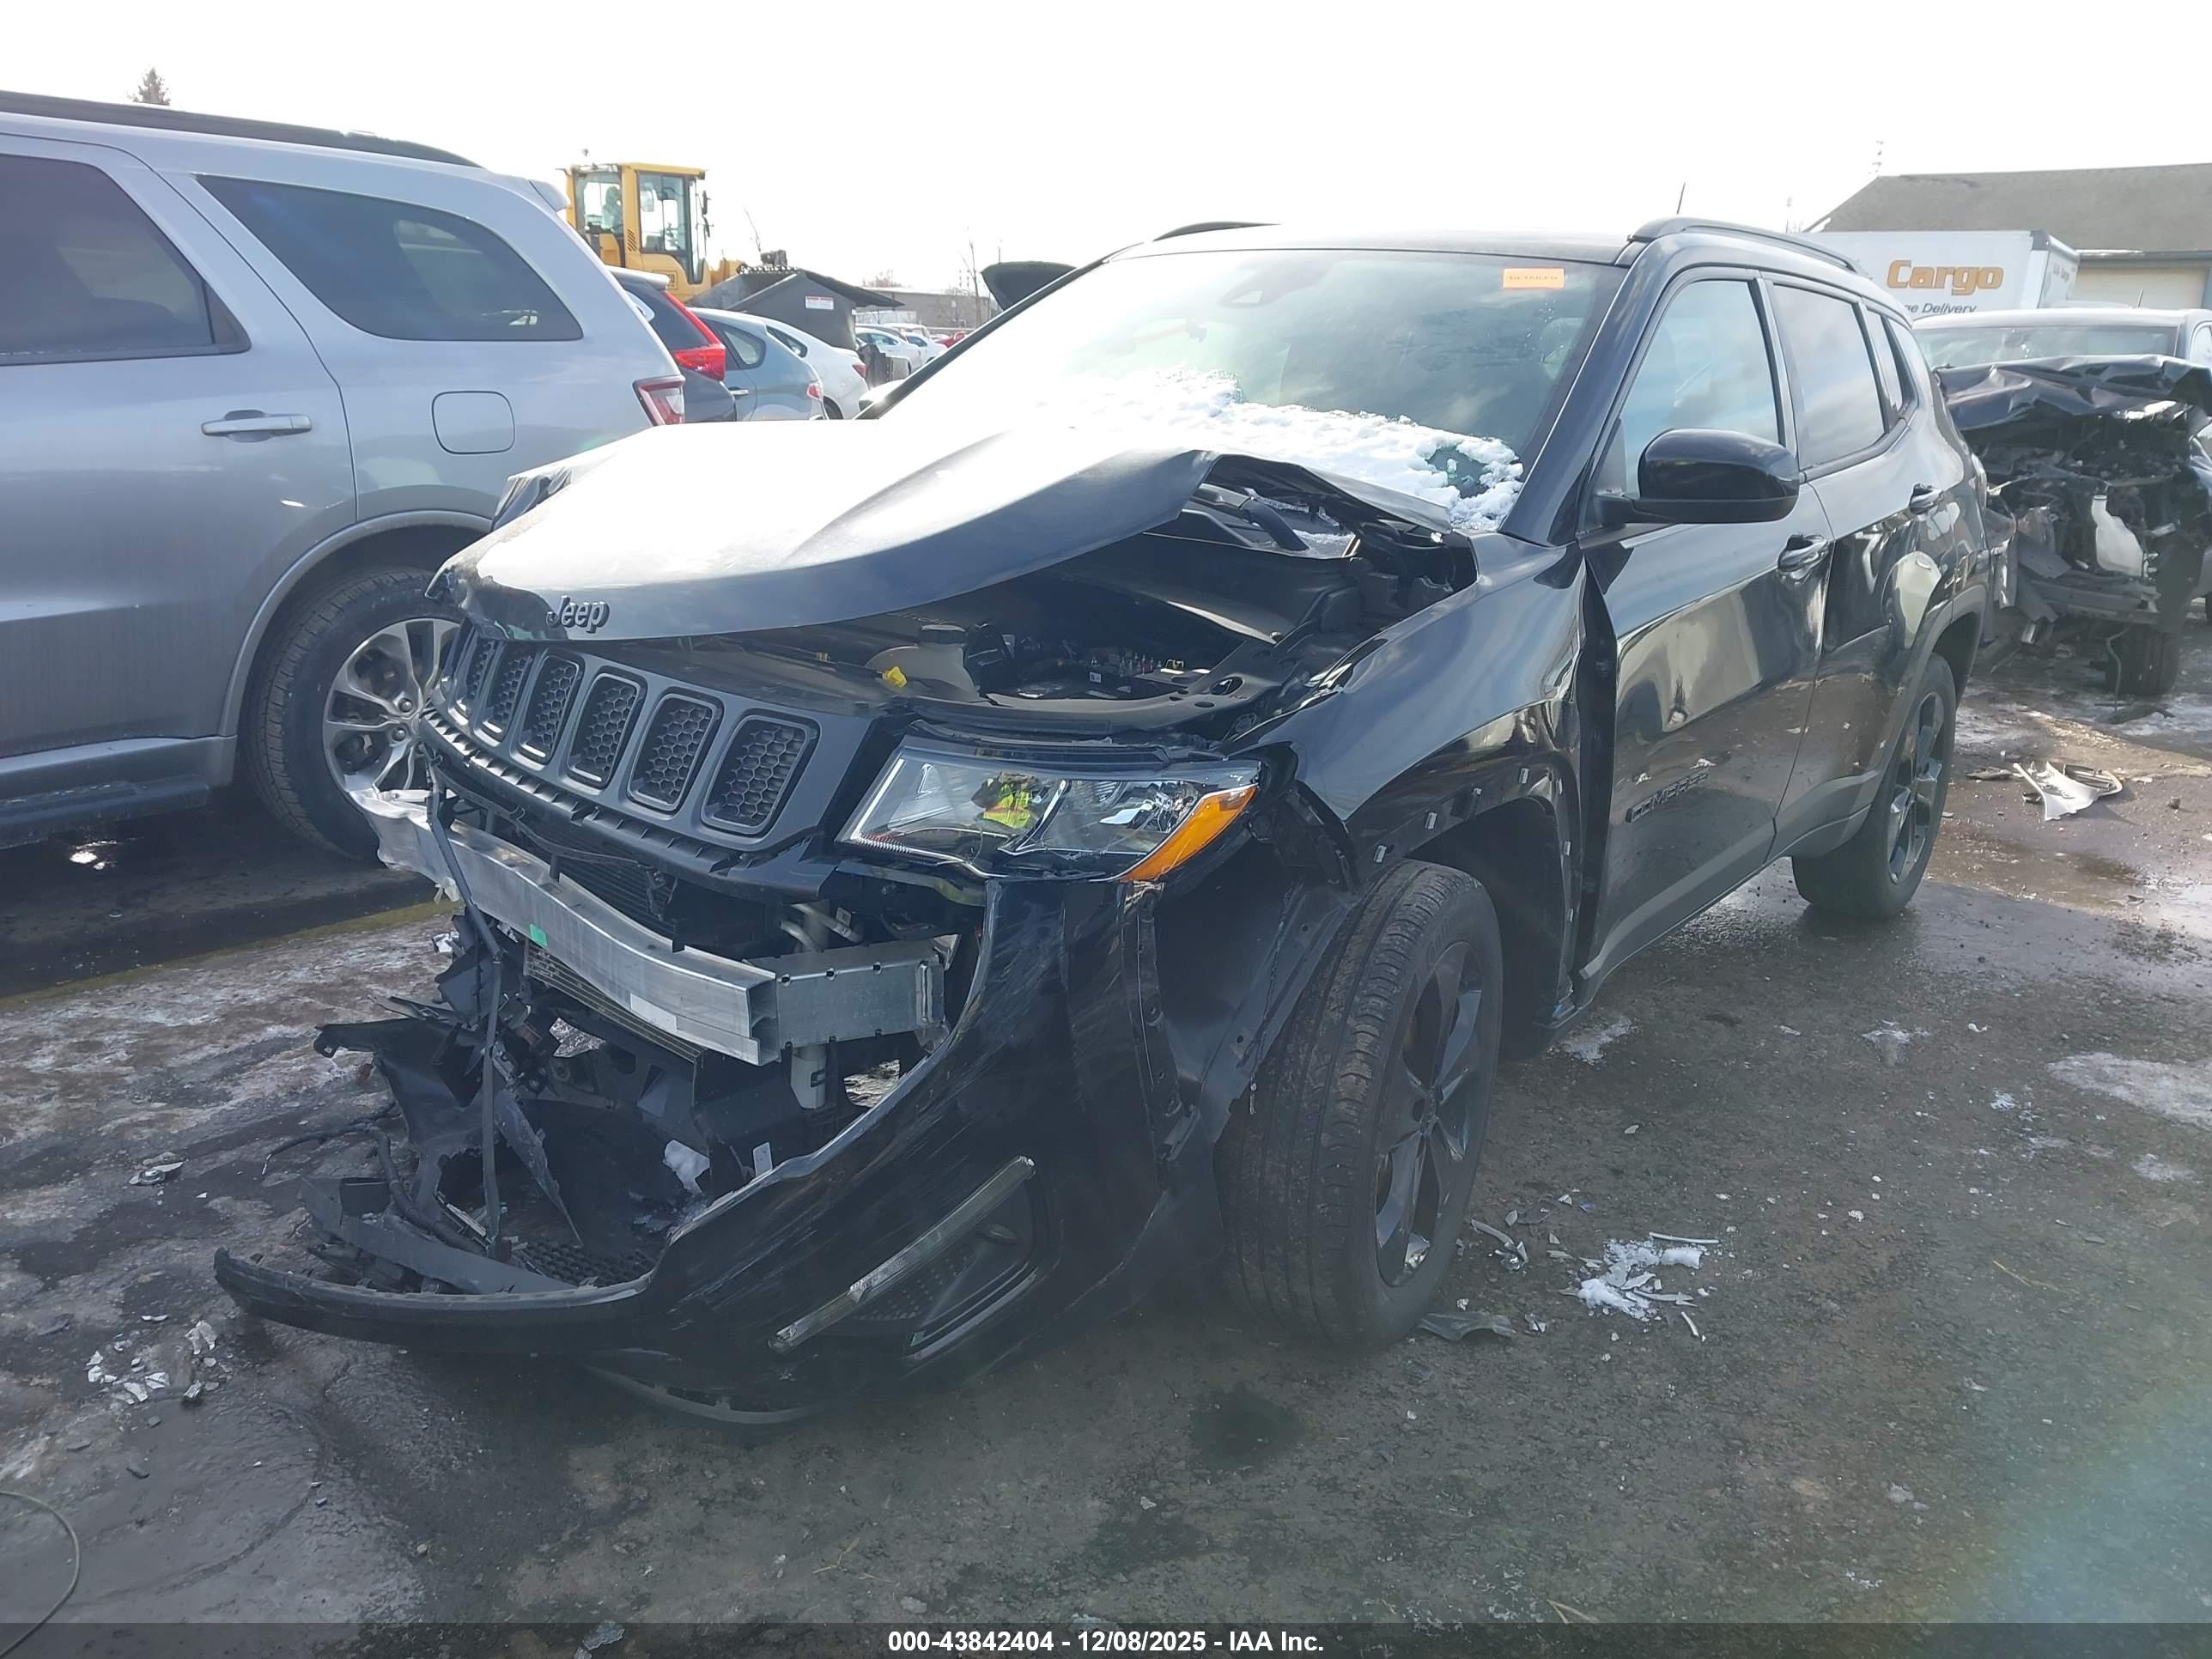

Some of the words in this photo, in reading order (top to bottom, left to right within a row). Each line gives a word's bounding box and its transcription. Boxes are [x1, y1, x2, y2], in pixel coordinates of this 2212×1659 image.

[1887, 259, 2004, 295] Cargo
[1922, 302, 1978, 313] Delivery
[546, 594, 611, 634] Jeep
